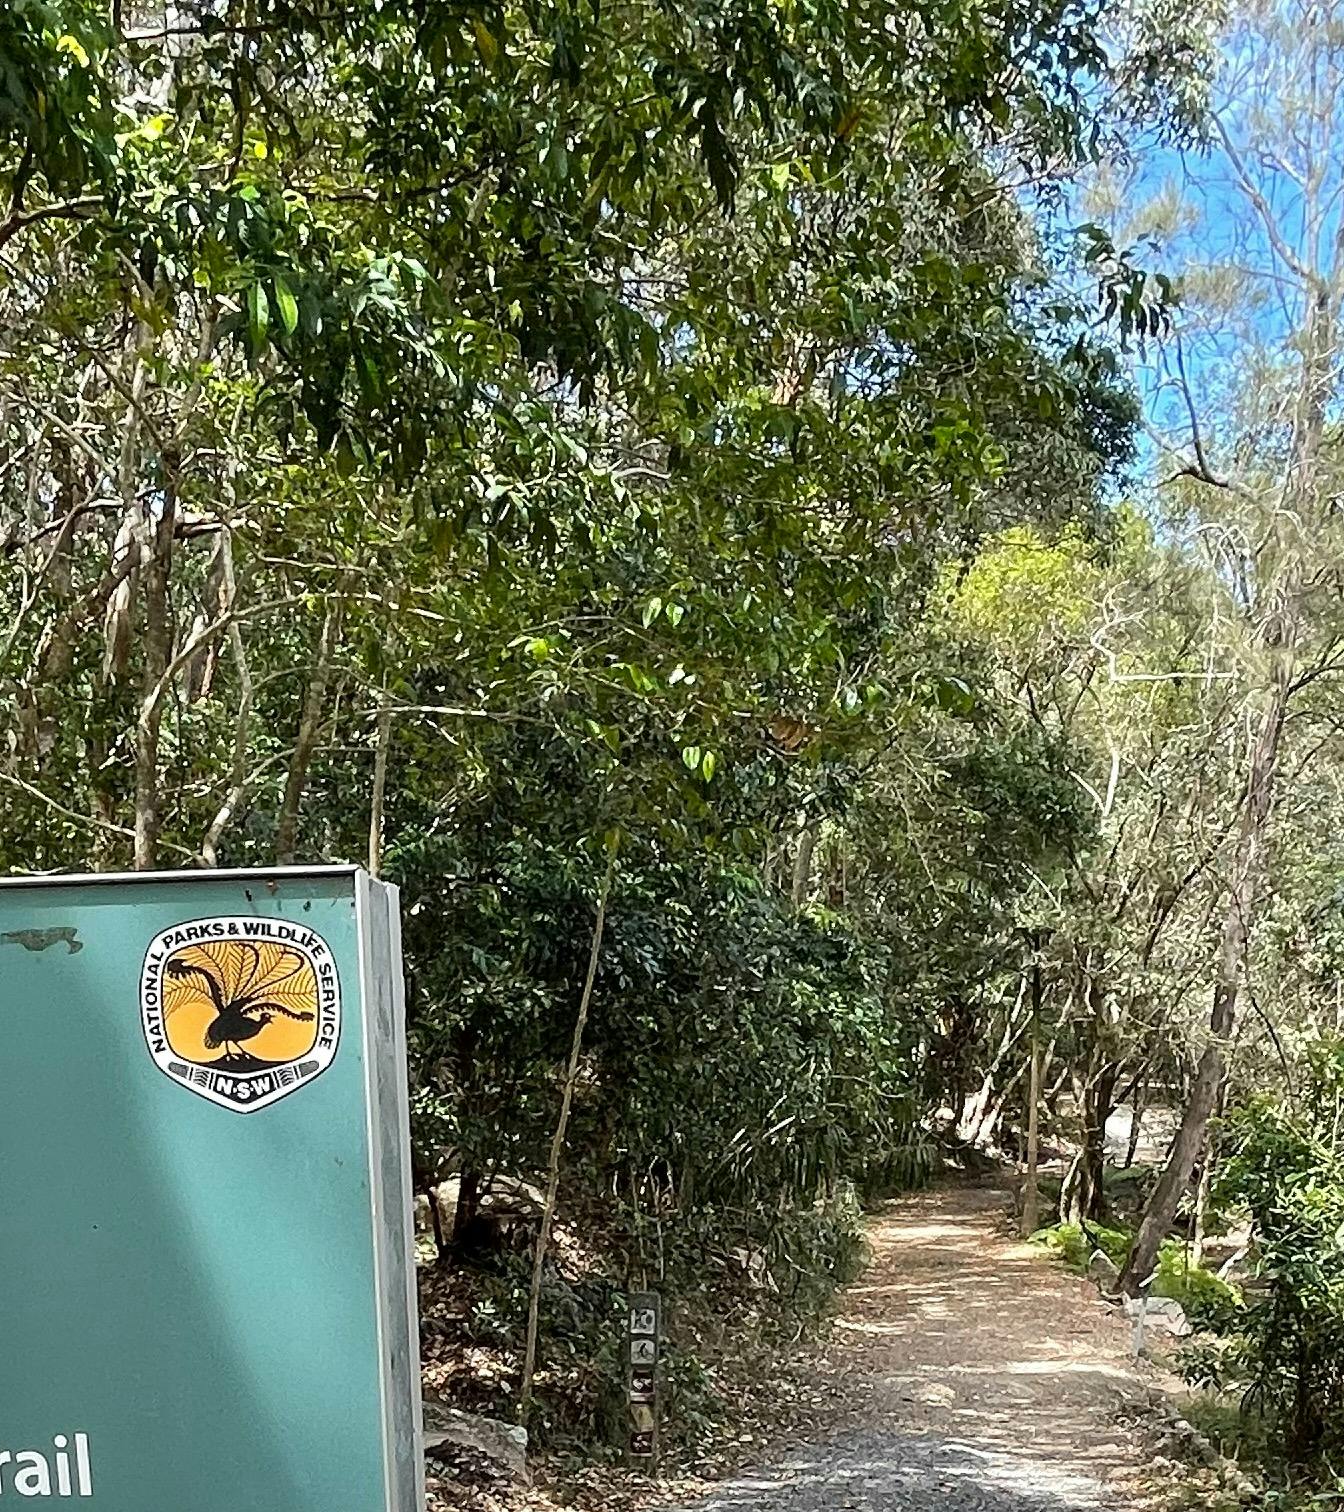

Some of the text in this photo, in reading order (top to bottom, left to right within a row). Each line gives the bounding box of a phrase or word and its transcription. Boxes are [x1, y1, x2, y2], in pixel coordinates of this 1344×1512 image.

[145, 922, 336, 1053] NATIONAL PARKS & WILDLIFE SERVICE
